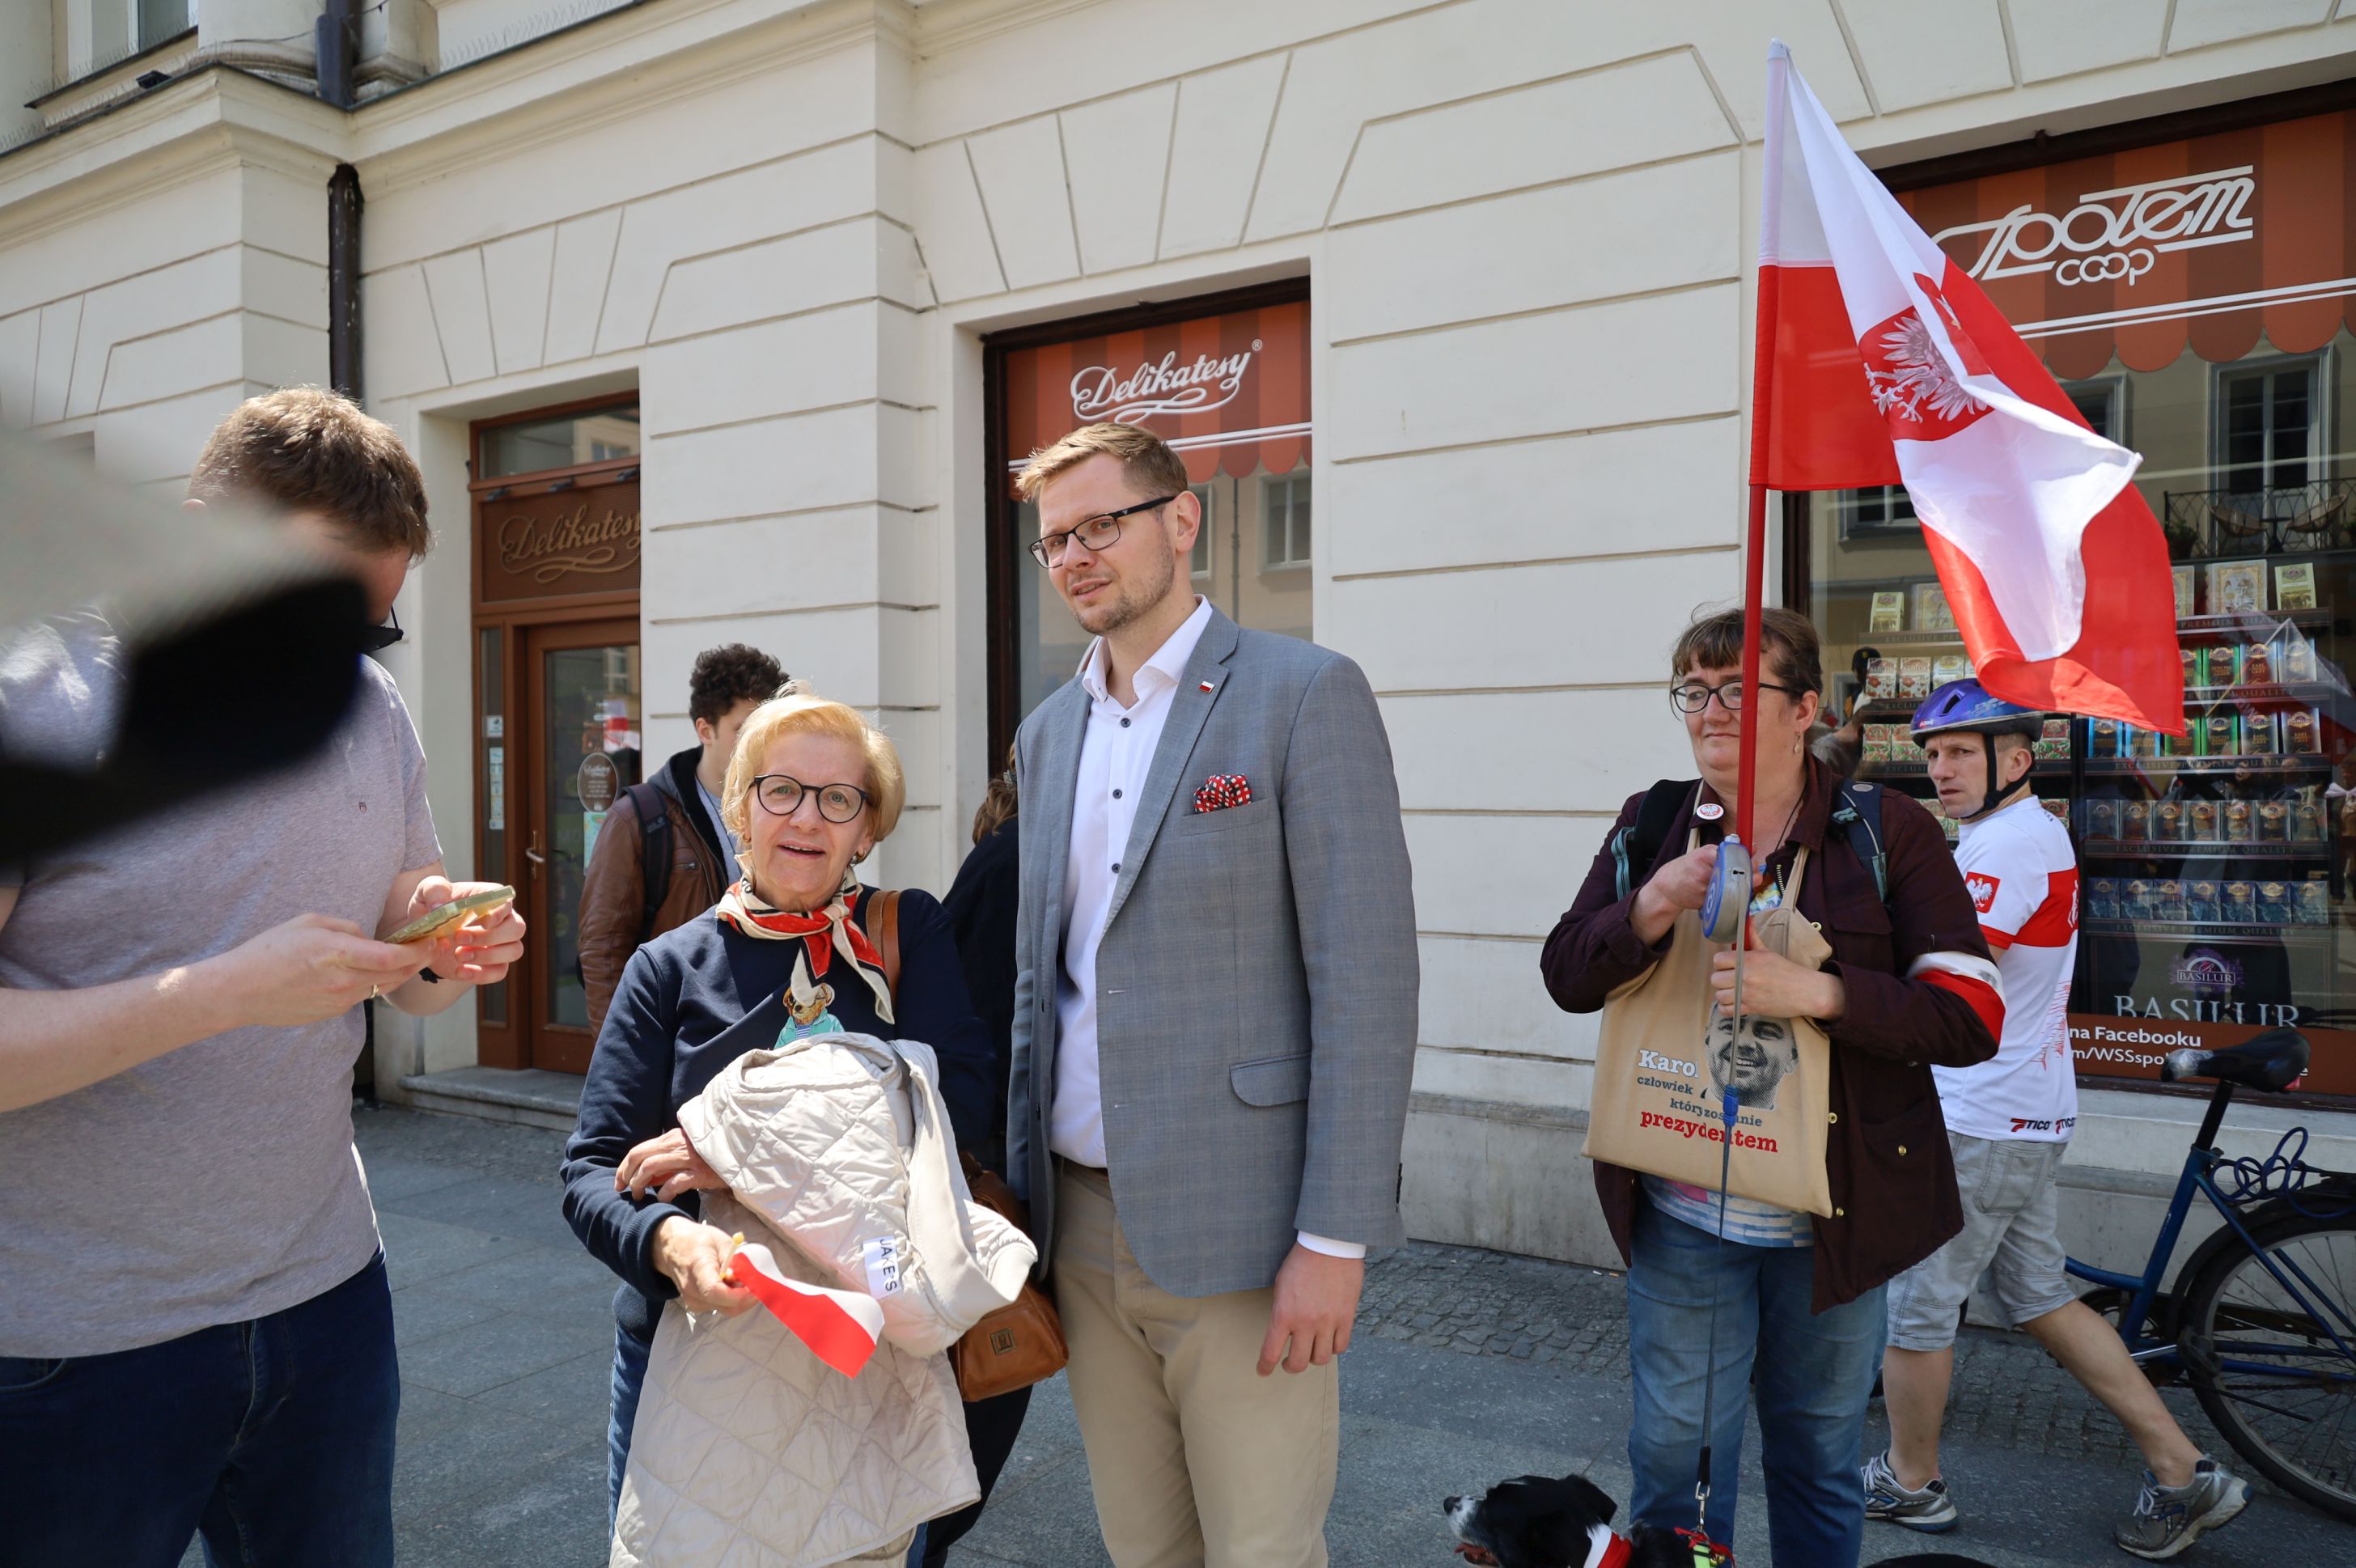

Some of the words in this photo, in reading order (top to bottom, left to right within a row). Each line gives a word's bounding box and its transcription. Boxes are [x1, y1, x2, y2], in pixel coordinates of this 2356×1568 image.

[2056, 248, 2155, 286] coop
[2185, 690, 2236, 699] REMIUM
[2117, 925, 2176, 933] EXCLUSIVE
[2183, 926, 2236, 934] PREMIUM
[2179, 972, 2233, 983] BASILUR
[2095, 1025, 2201, 1048] Facebooku
[1637, 1075, 1693, 1095] człowiek
[1704, 1108, 1762, 1127] zosnie
[1640, 1110, 1778, 1153] prezydentem
